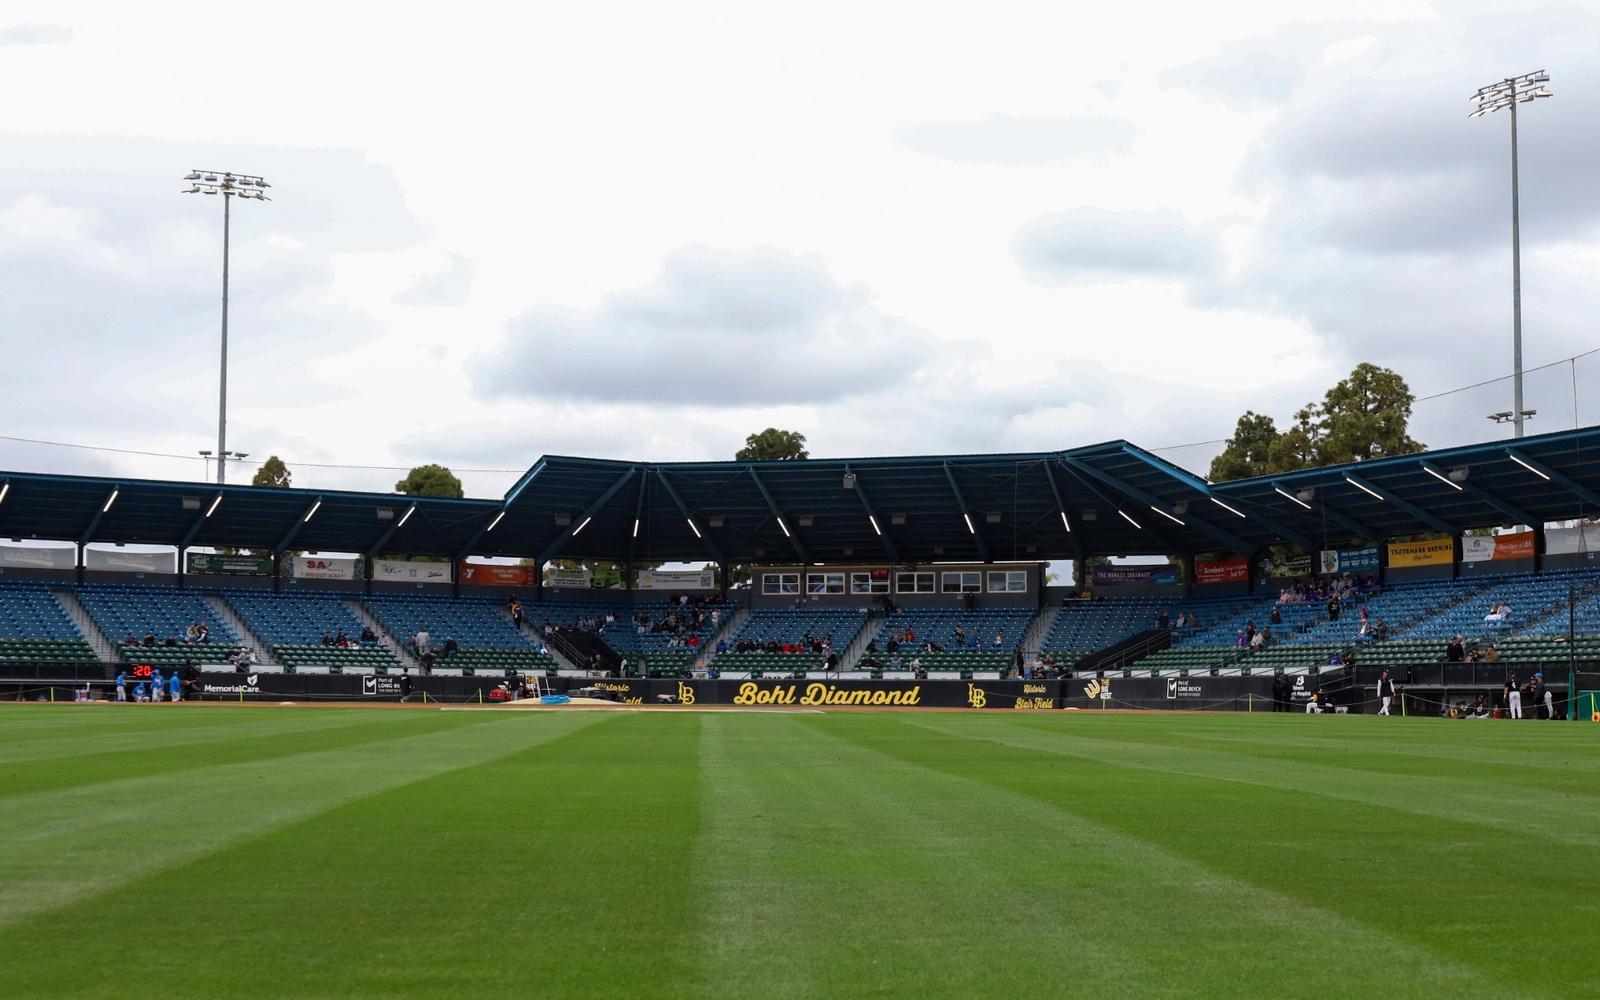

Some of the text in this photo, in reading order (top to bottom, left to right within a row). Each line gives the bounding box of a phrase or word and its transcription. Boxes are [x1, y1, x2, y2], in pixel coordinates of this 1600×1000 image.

[1391, 544, 1453, 555] TRADEMARK BREWING
[204, 684, 262, 693] MemorialCare
[733, 682, 921, 706] Bohl Diamond
[1023, 683, 1047, 694] Historic
[1015, 697, 1055, 709] Blair Field
